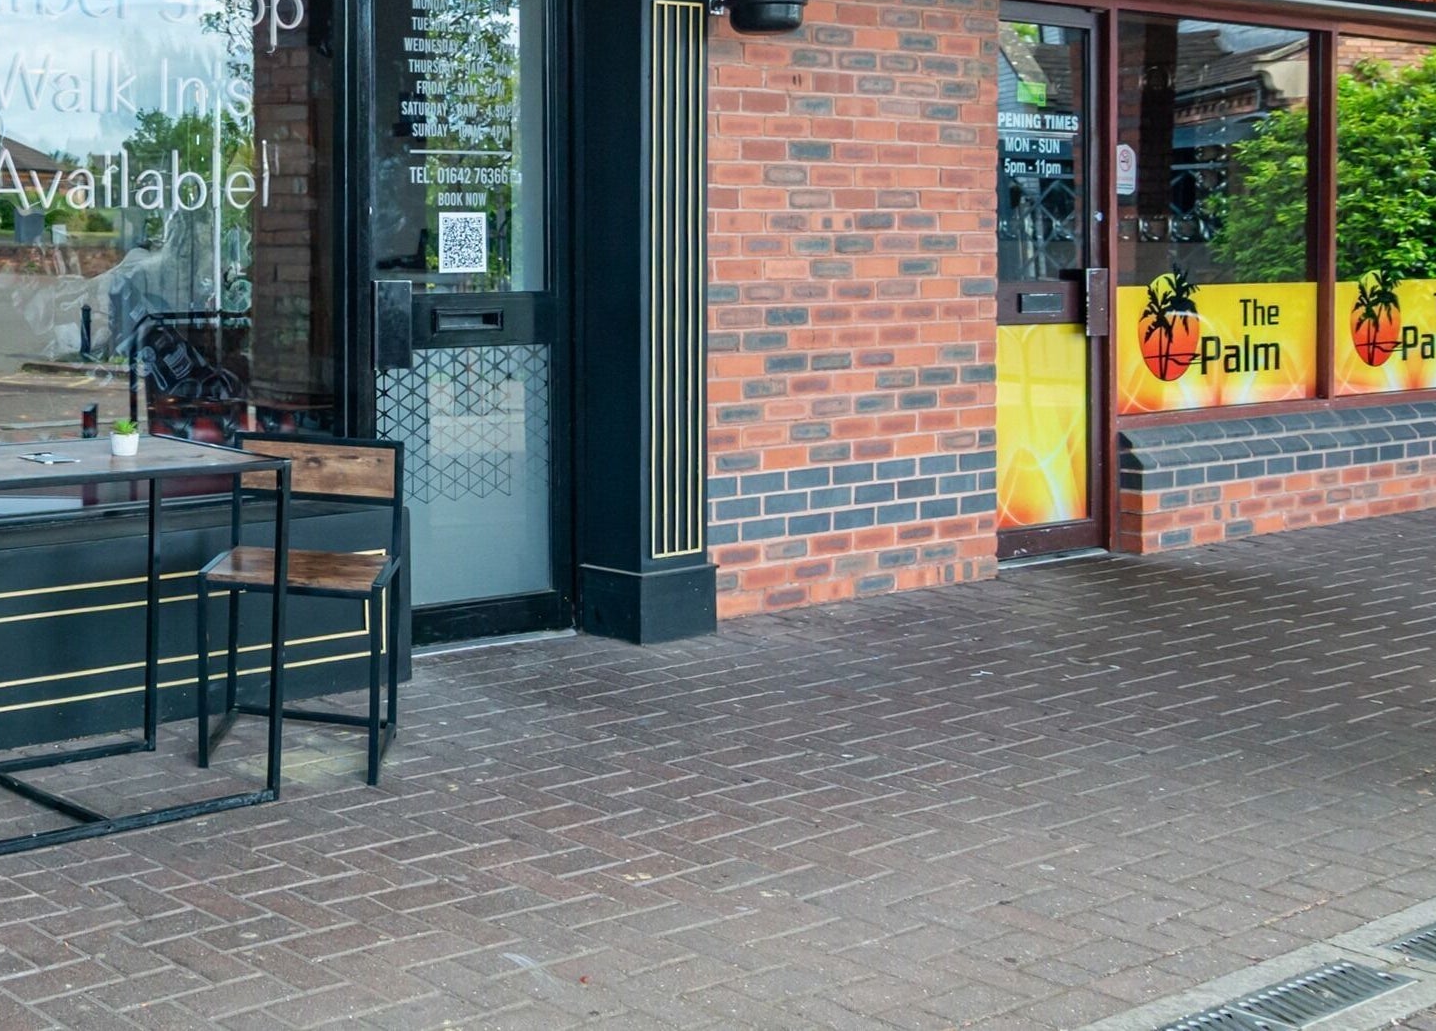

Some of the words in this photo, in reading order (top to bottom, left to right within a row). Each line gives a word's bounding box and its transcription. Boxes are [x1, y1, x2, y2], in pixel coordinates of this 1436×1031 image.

[411, 16, 451, 31] TUESDAY
[404, 37, 459, 53] WEDNESDAY
[408, 58, 455, 74] THURSDAY
[416, 80, 448, 95] FRIDAY
[457, 82, 478, 96] 9AM
[401, 101, 448, 117] SATURDAY
[997, 112, 1041, 129] PENING
[1043, 114, 1079, 131] TIMES
[412, 122, 449, 138] SUNDAY
[491, 125, 510, 140] 4PM
[1004, 137, 1030, 152] MON
[1038, 138, 1061, 154] SUN
[437, 167, 471, 185] 01642
[474, 168, 515, 185] 76366
[1004, 158, 1026, 177] 5pm
[1034, 159, 1062, 178] 11pm
[438, 192, 463, 207] BOOK
[465, 192, 487, 207] NOW
[1239, 298, 1280, 327] The
[1402, 325, 1435, 361] Pa
[1200, 334, 1281, 375] Palm
